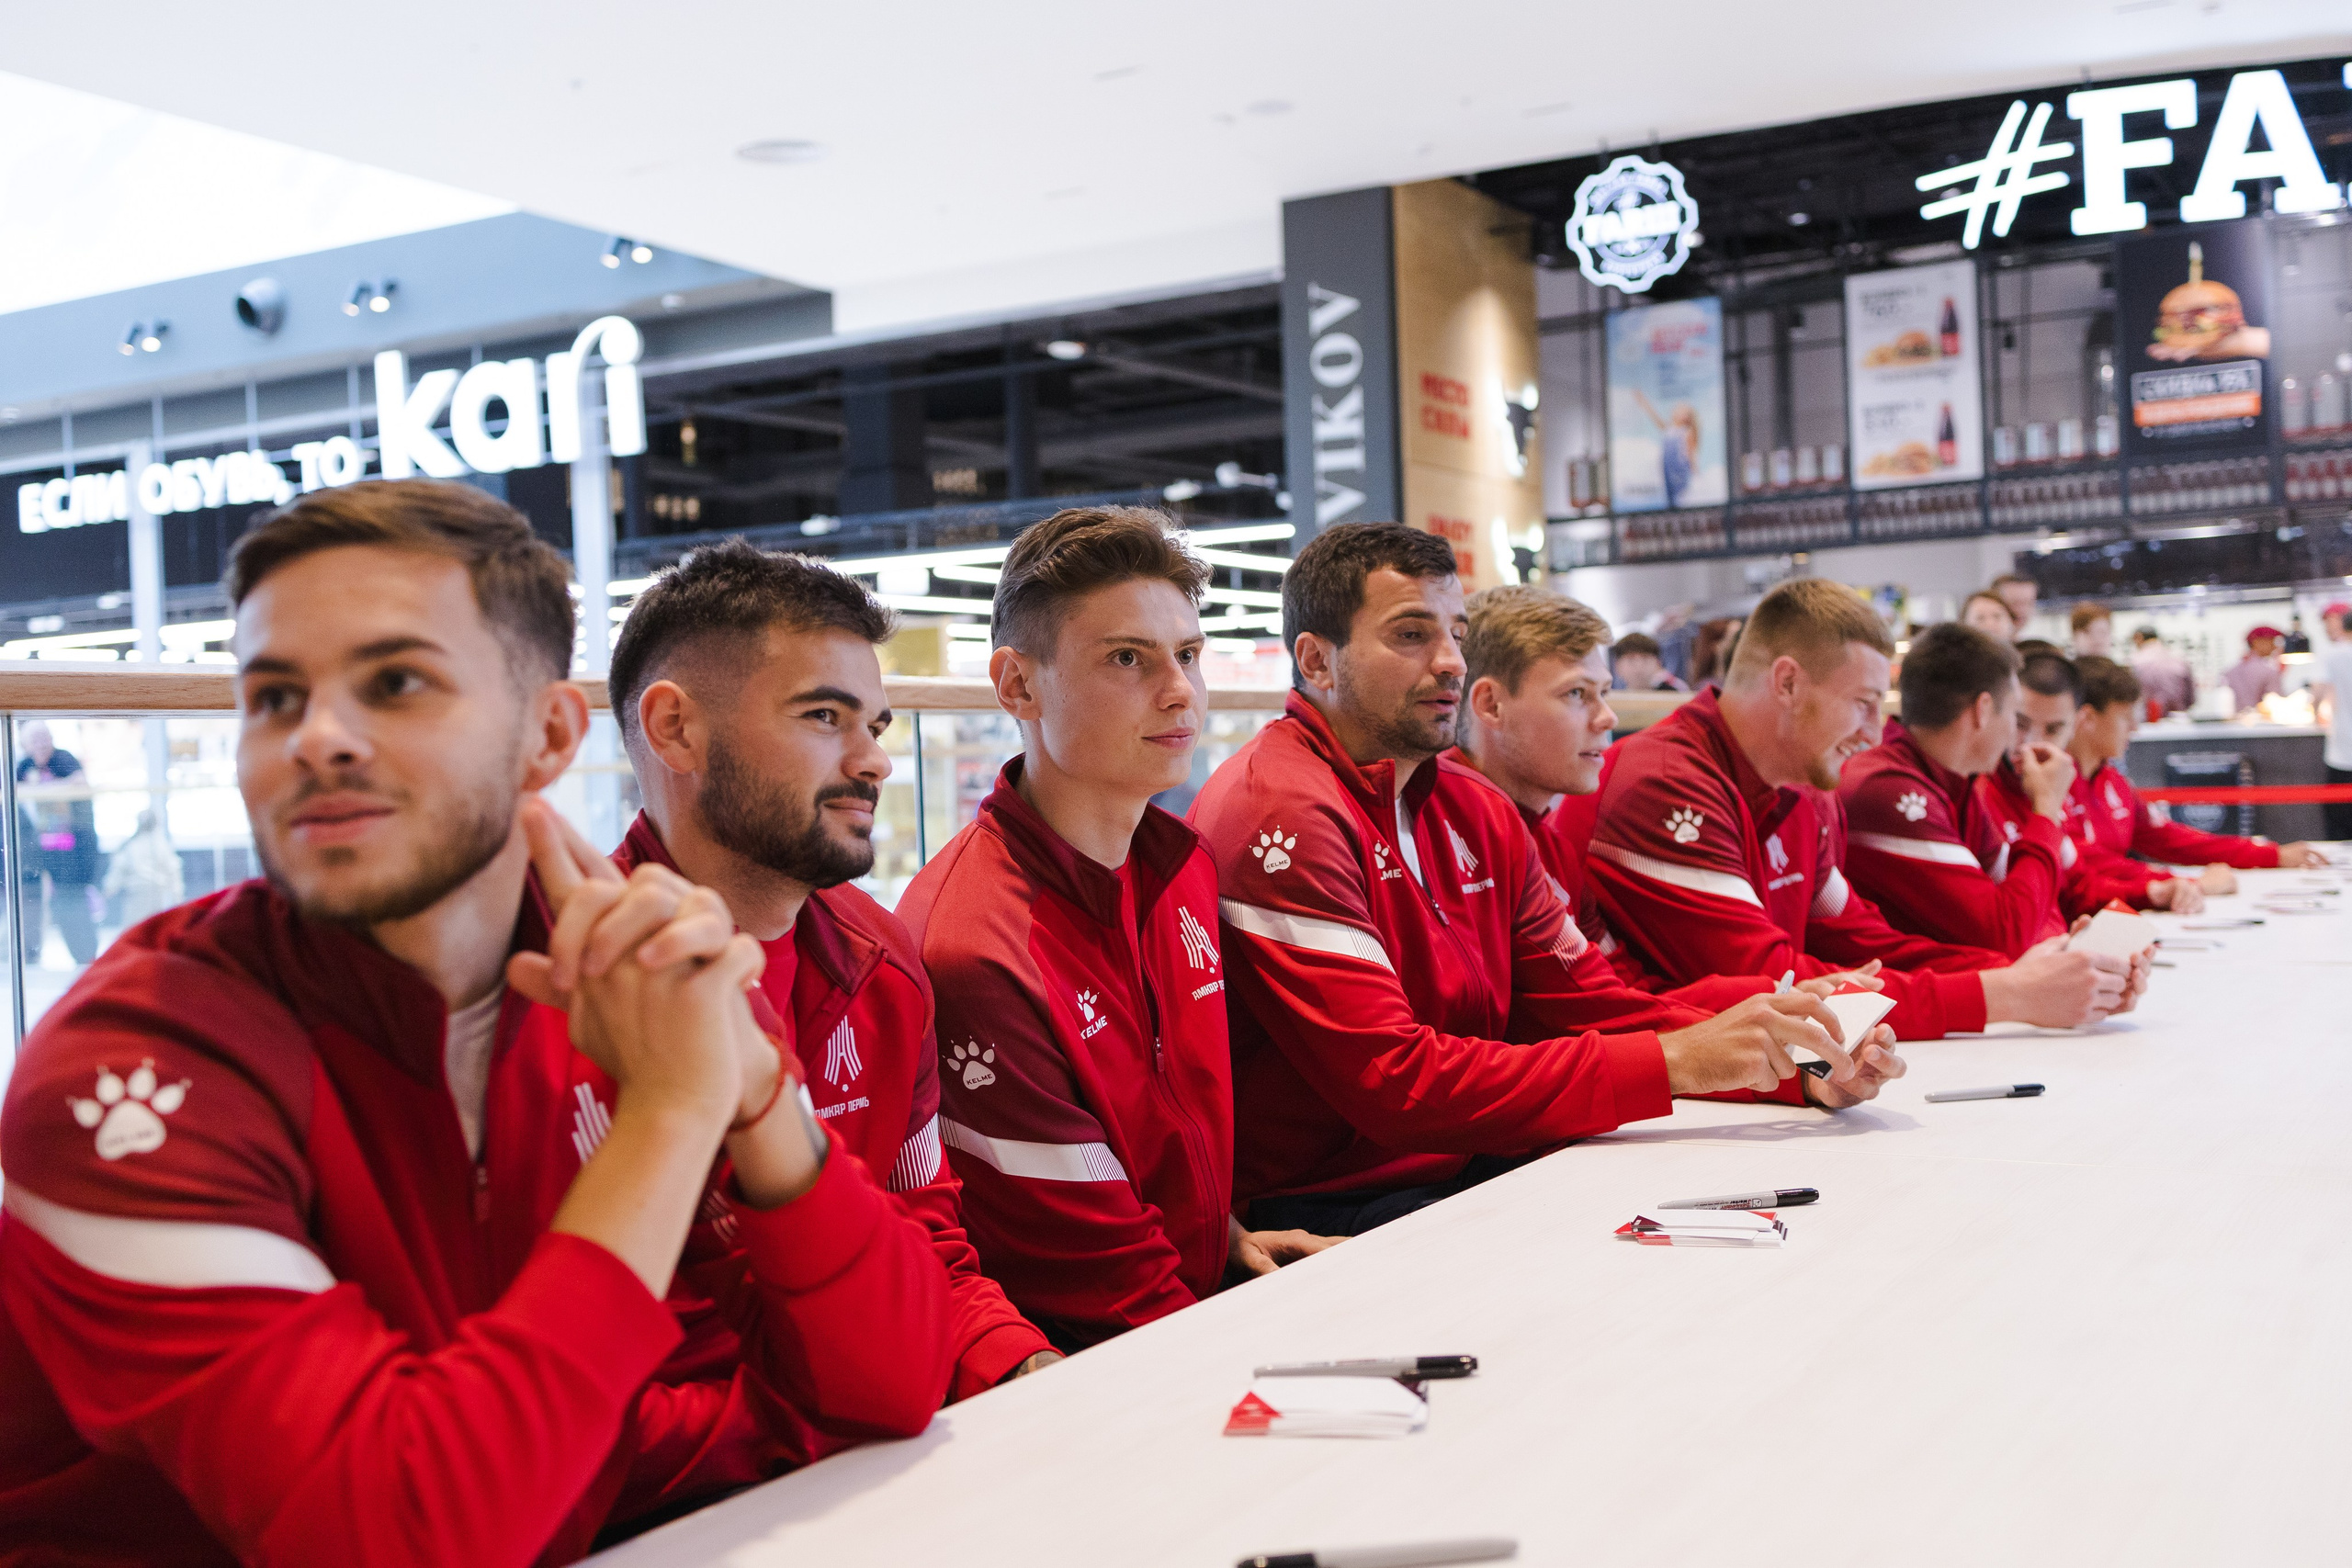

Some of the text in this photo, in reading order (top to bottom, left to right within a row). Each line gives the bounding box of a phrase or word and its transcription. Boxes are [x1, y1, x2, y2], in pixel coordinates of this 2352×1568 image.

[1915, 61, 2352, 250] #FA
[373, 315, 647, 479] kari
[17, 469, 129, 535] ЕСЛИ
[290, 434, 362, 494] ТО
[1266, 859, 1289, 869] KELME
[848, 1096, 870, 1112] ПЕРМЬ
[966, 1073, 993, 1085] KELME
